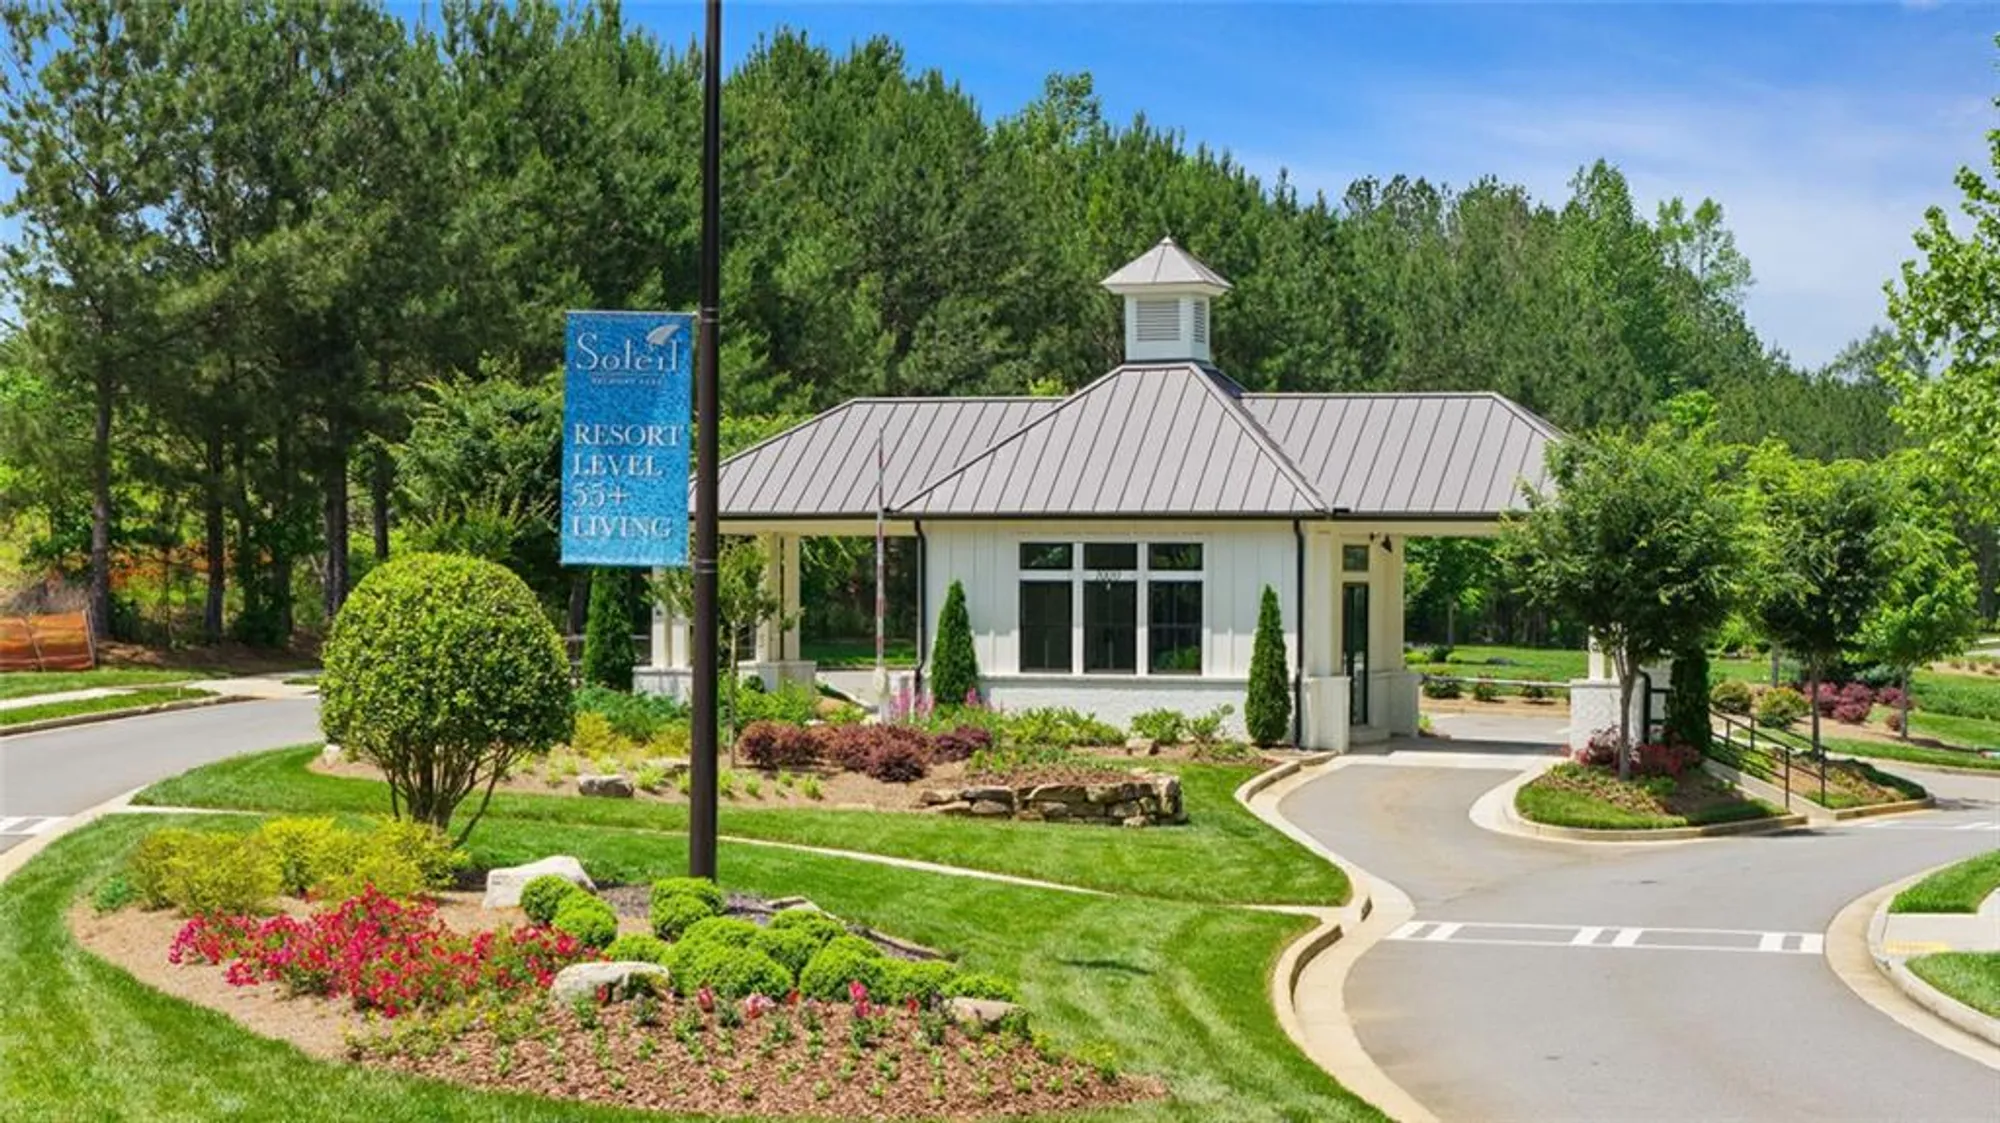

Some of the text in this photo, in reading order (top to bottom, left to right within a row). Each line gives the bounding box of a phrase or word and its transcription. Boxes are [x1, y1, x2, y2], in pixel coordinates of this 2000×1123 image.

[574, 424, 683, 447] RESORT
[573, 455, 663, 477] LEVEL
[572, 483, 629, 508] 55+
[573, 515, 672, 538] LIVING
